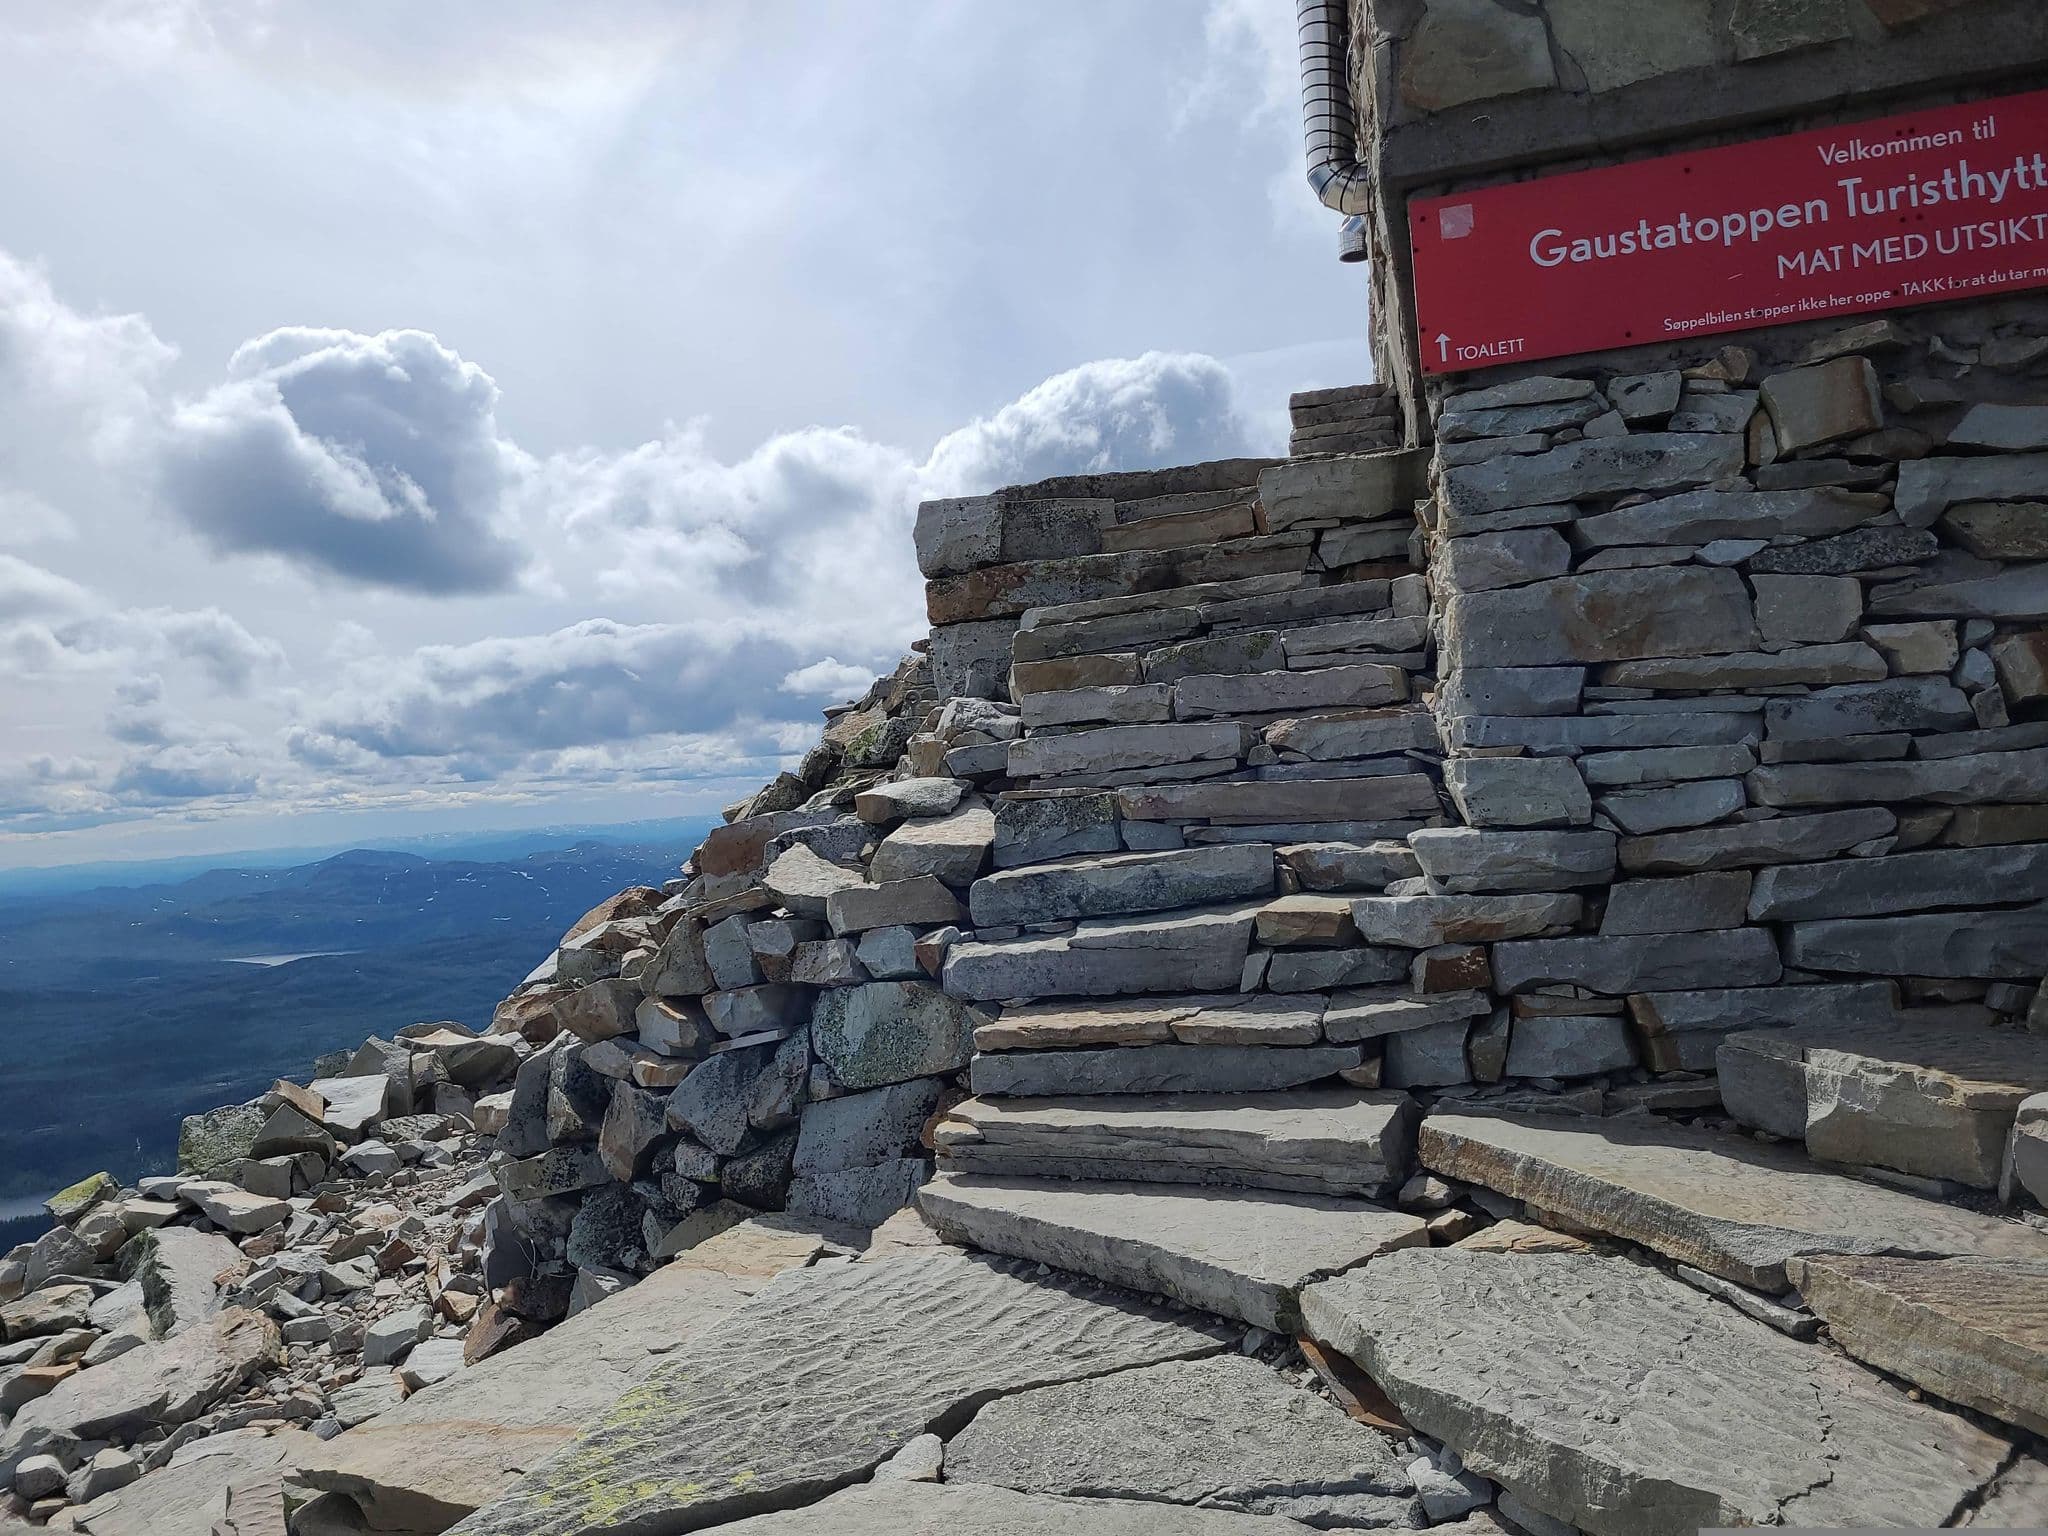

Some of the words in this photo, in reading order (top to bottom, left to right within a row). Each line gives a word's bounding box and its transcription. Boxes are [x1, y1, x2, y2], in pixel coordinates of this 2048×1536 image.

[1817, 129, 1963, 166] Velkommen
[1972, 115, 1996, 140] til
[1528, 198, 1829, 268] Gaustatoppen
[1837, 153, 2048, 218] Turisthytt
[1776, 245, 1845, 279] MAT
[1852, 233, 1929, 268] MED
[1935, 213, 2048, 255] UTSIKT
[1663, 309, 1742, 332] Søppelbilen
[1743, 304, 1797, 320] stopper
[1797, 296, 1828, 312] ikke
[1829, 293, 1854, 307] her
[1855, 290, 1891, 305] oppe
[1901, 277, 1946, 297] TAKK
[1971, 273, 1986, 287] at
[1988, 269, 2006, 284] du
[2009, 269, 2031, 281] tar
[1455, 338, 1525, 361] TOALETT
